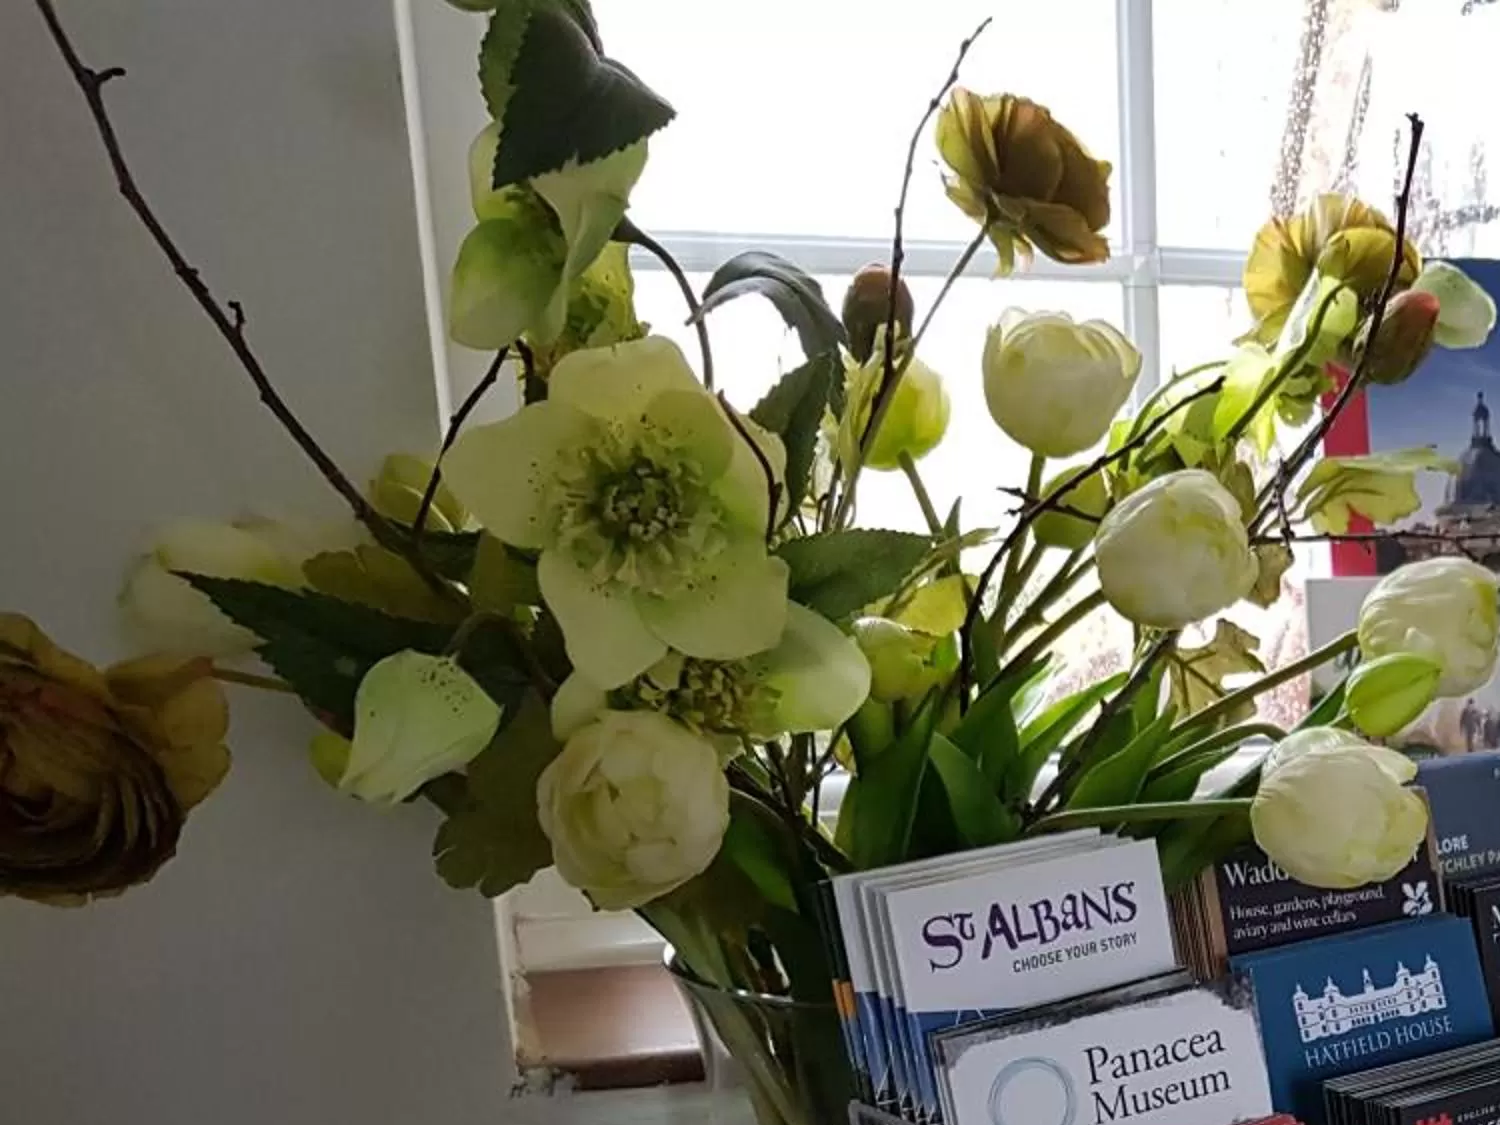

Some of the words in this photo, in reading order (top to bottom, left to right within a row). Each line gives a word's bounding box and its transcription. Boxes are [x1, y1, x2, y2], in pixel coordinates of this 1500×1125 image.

[1436, 833, 1469, 855] LORE
[1438, 850, 1485, 875] TCHLEY
[1270, 918, 1292, 934] and
[1012, 950, 1063, 974] CHOOSE
[1063, 942, 1098, 961] YOUR
[1099, 931, 1138, 953] STORY
[1082, 1028, 1227, 1085] Panacea
[1304, 1031, 1391, 1069] HATFIELD
[1395, 1015, 1453, 1045] HOUSE
